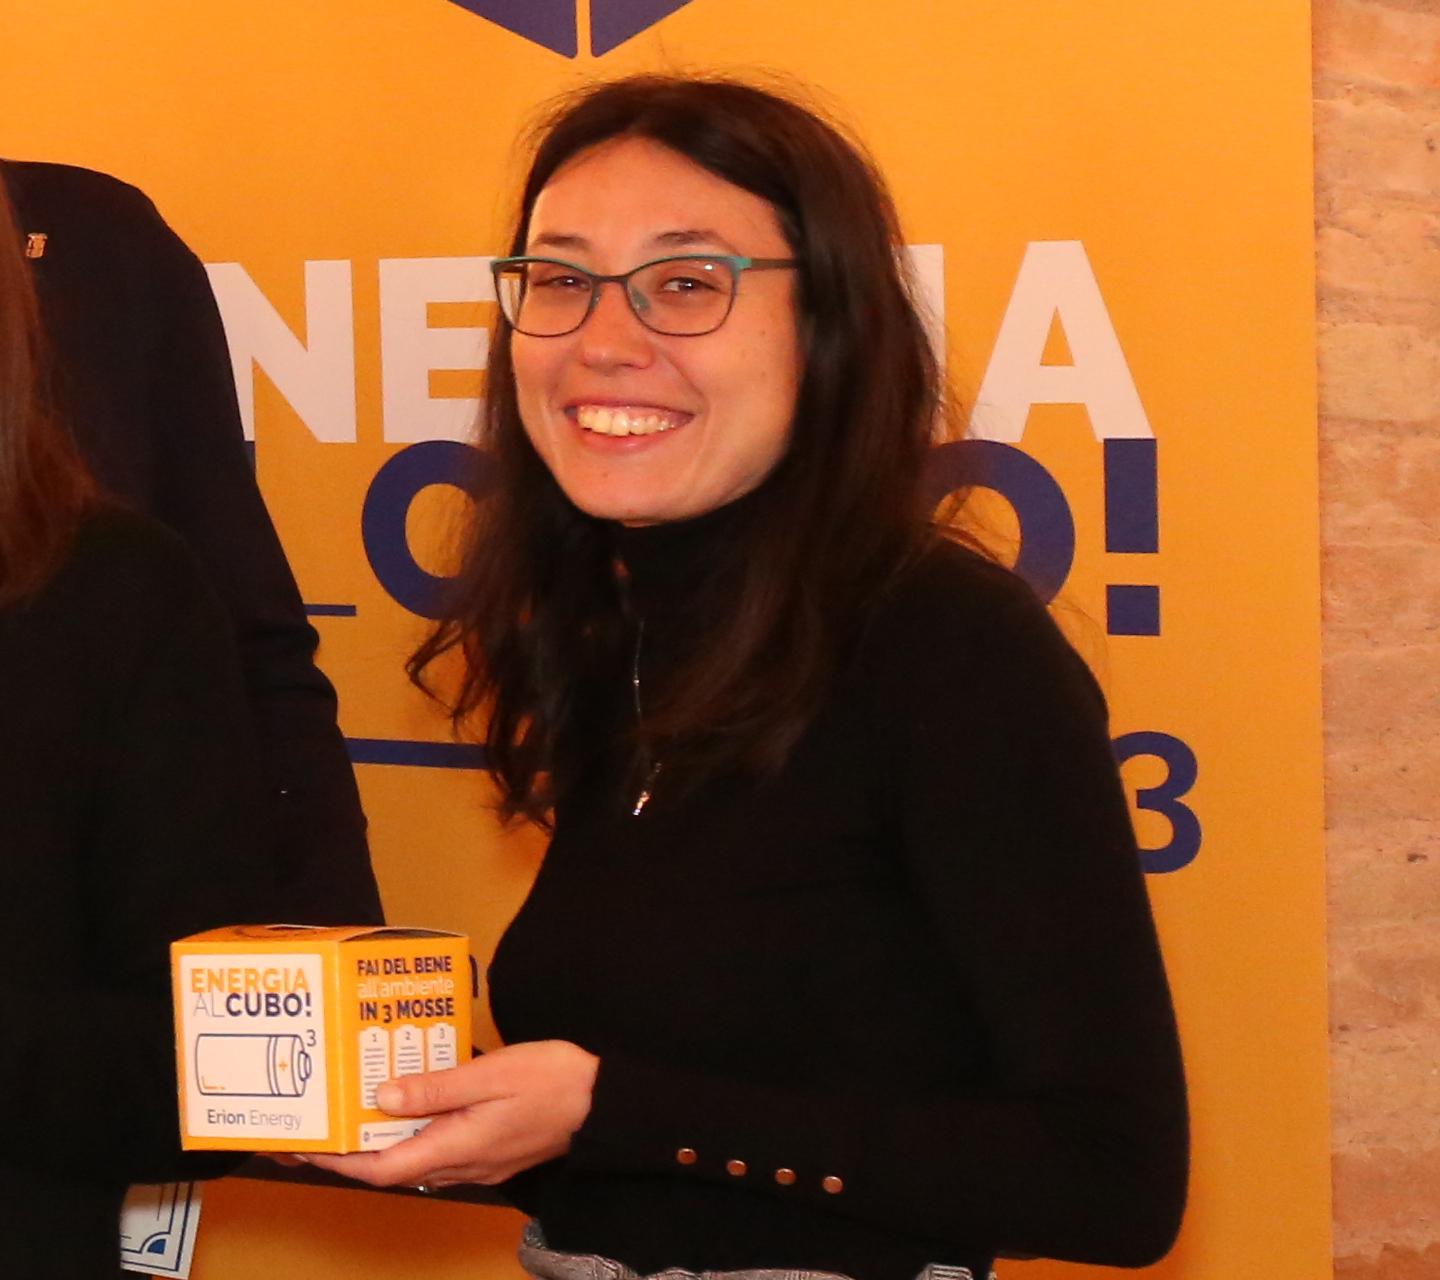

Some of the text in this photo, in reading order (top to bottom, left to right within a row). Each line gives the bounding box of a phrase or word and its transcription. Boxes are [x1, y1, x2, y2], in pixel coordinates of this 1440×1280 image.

[1111, 731, 1202, 873] 3
[357, 955, 453, 976] FAI DEL BENE
[190, 967, 310, 993] ENERGIA
[226, 992, 312, 1018] CUBO!
[359, 996, 455, 1023] IN 3 MOSSE
[306, 1028, 317, 1047] 3
[207, 1108, 302, 1130] Erion Energy
